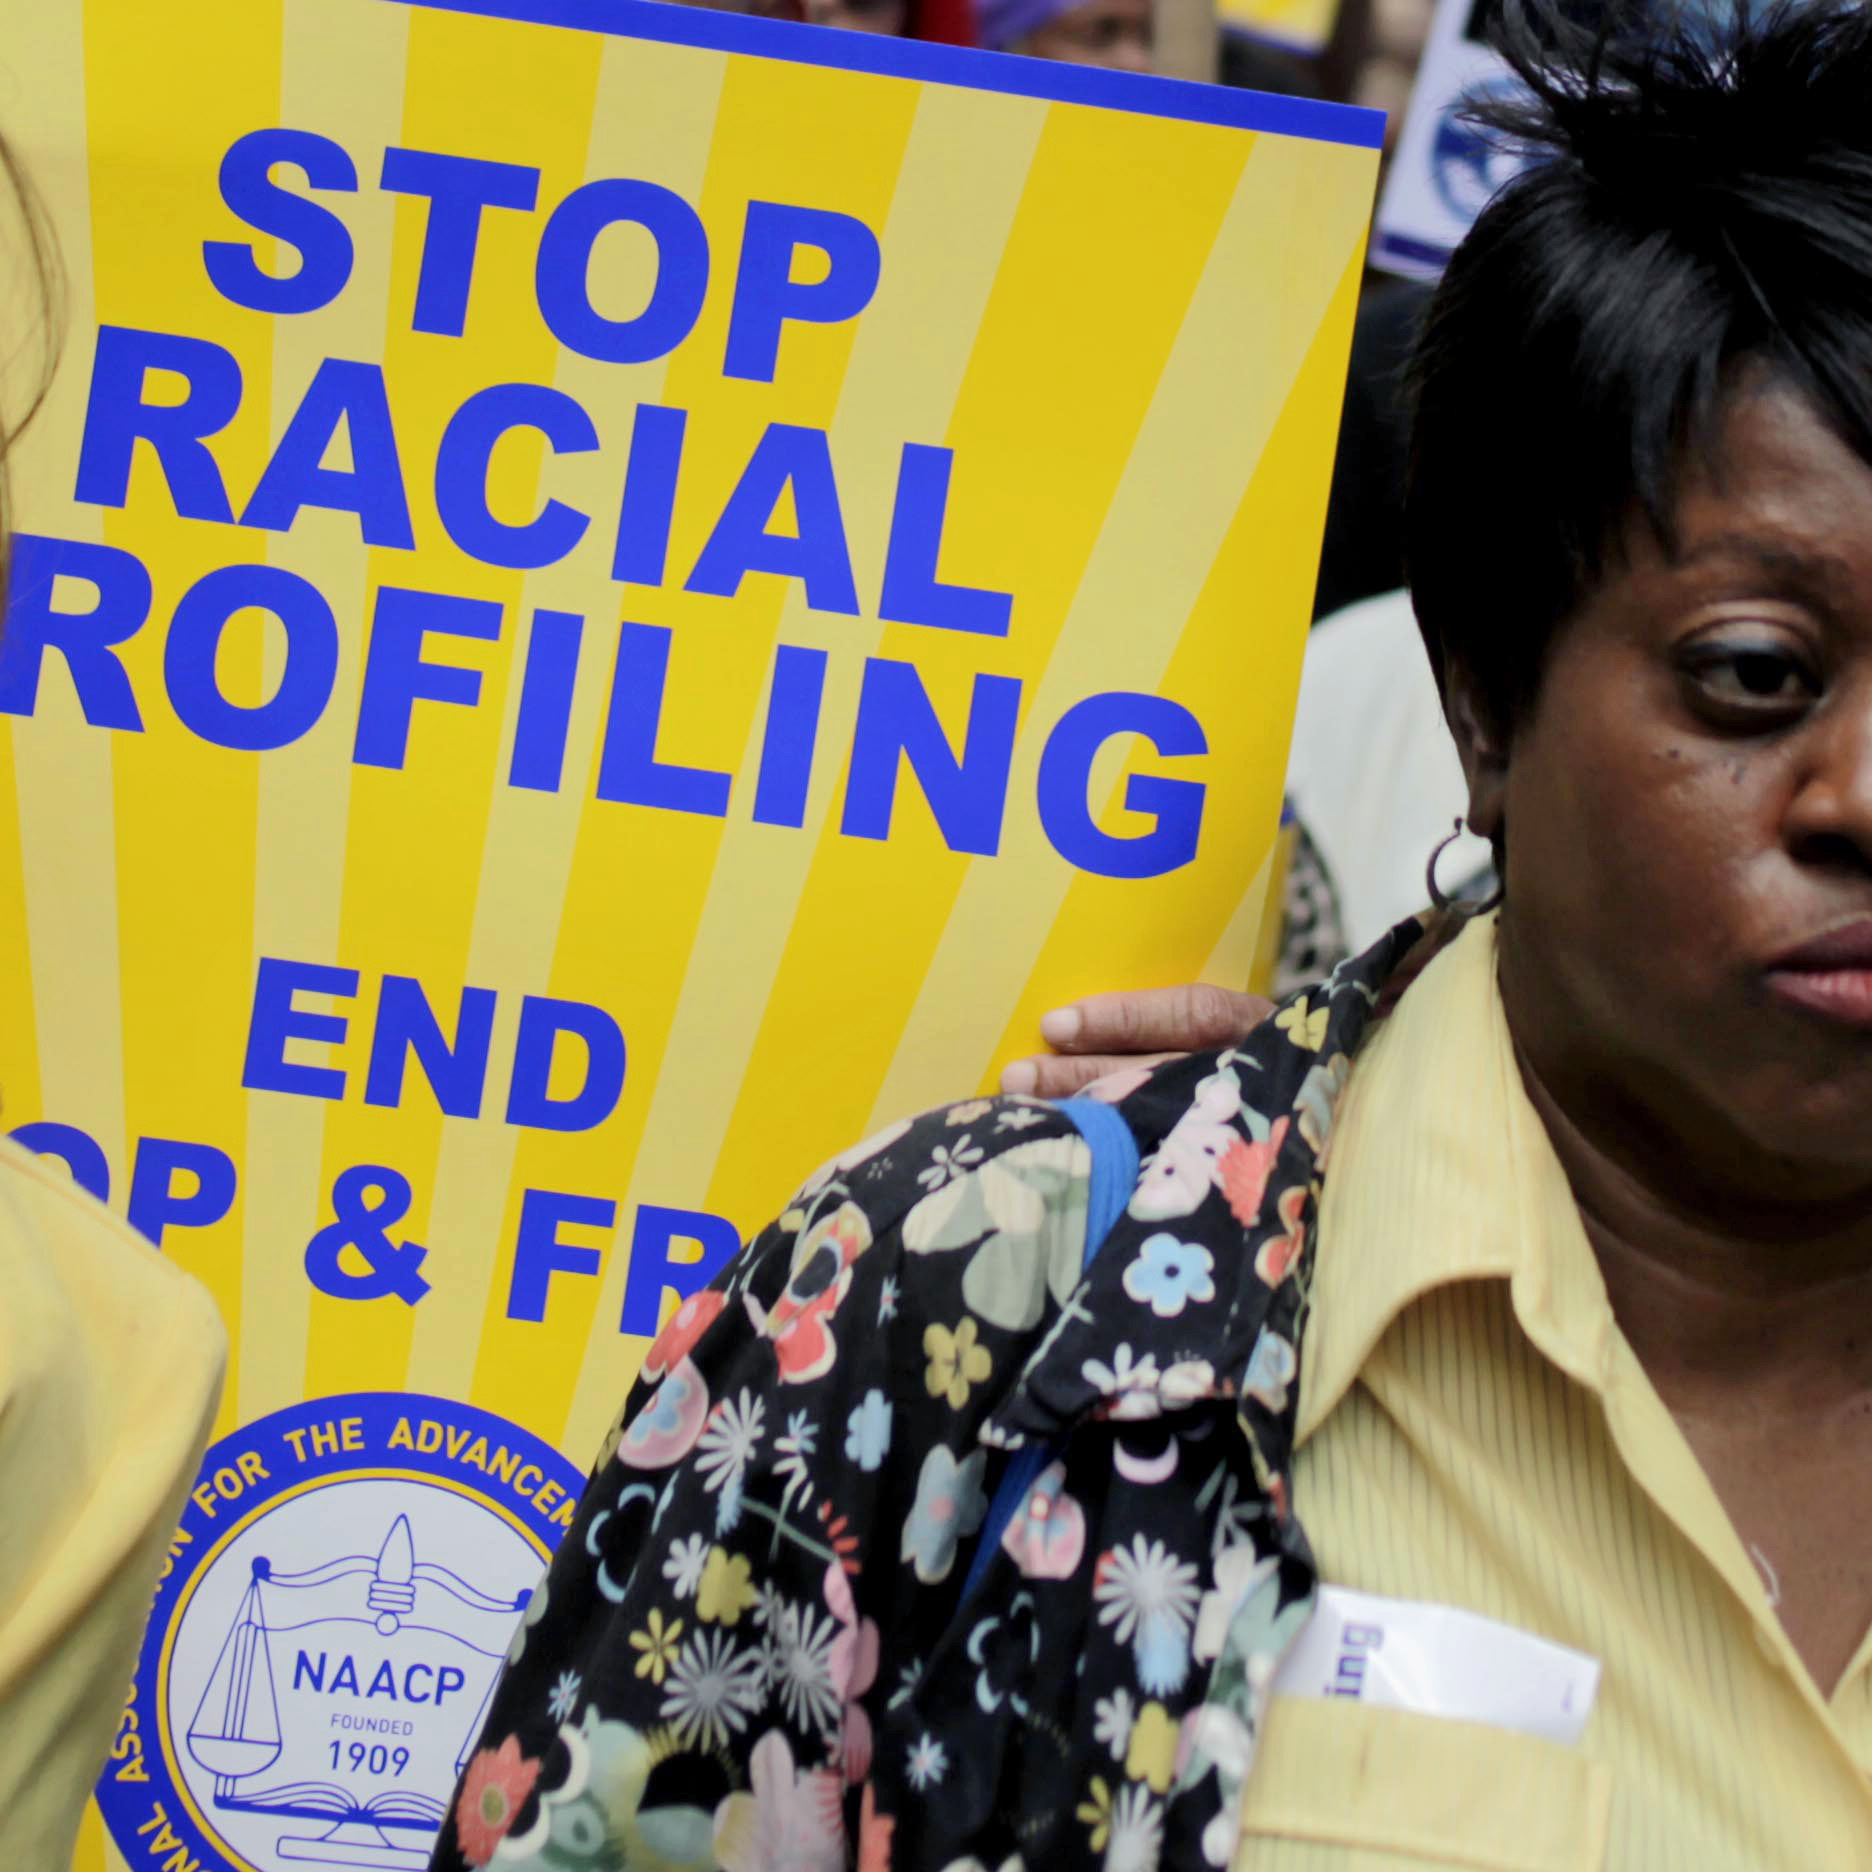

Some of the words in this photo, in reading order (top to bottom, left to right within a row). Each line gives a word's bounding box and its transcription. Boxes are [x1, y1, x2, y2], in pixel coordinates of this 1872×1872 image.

[202, 128, 882, 384] STOP
[73, 324, 1014, 638] RACIAL
[241, 956, 628, 1133] END
[304, 1164, 432, 1308] &
[192, 1450, 271, 1518] FOR
[283, 1416, 365, 1463] THE
[293, 1649, 466, 1707] NAACP
[331, 1713, 414, 1737] FOUNDED
[328, 1739, 410, 1778] 1909
